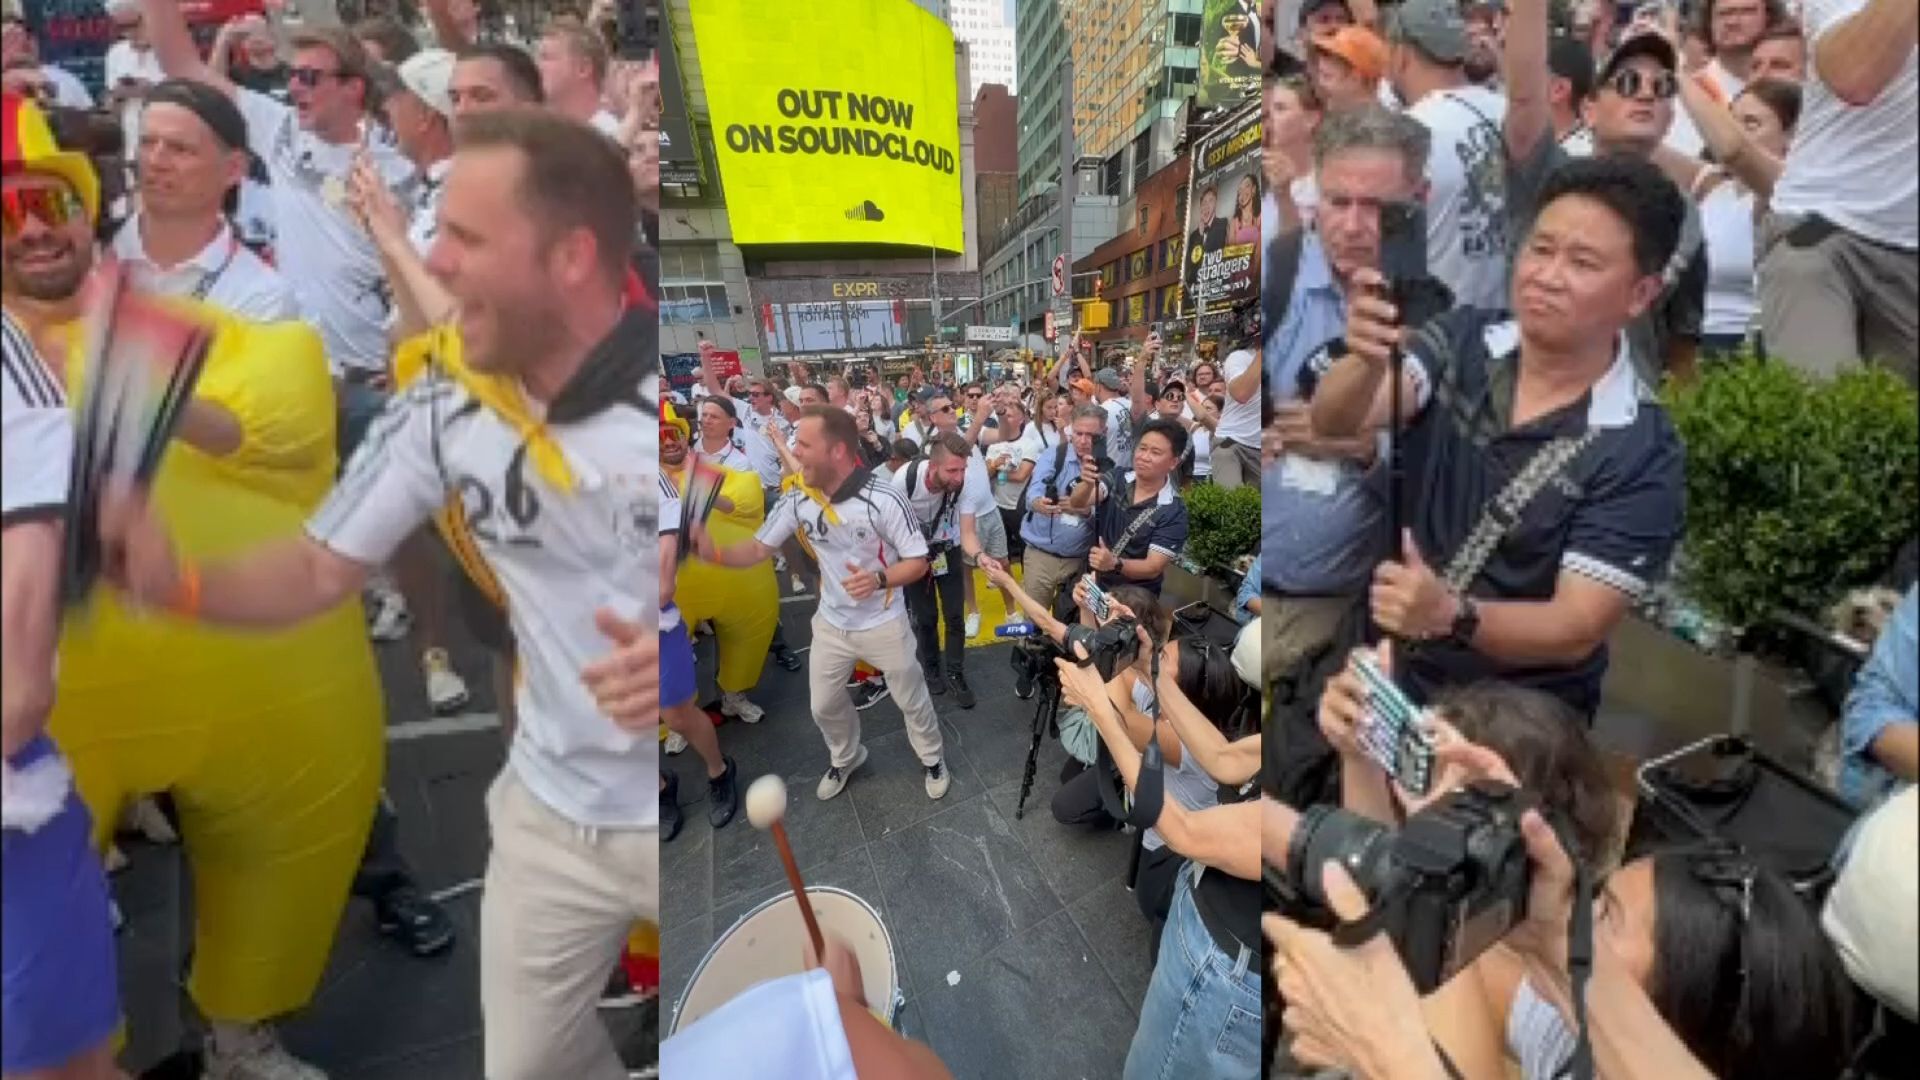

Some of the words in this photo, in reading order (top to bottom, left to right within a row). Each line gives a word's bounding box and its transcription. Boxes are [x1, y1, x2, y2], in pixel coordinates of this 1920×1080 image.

[777, 89, 842, 119] OUT
[847, 92, 913, 130] NOW
[726, 124, 774, 154] ON
[778, 125, 954, 175] SOUNDCLOUD
[1197, 255, 1250, 282] strangers
[1203, 249, 1223, 266] two
